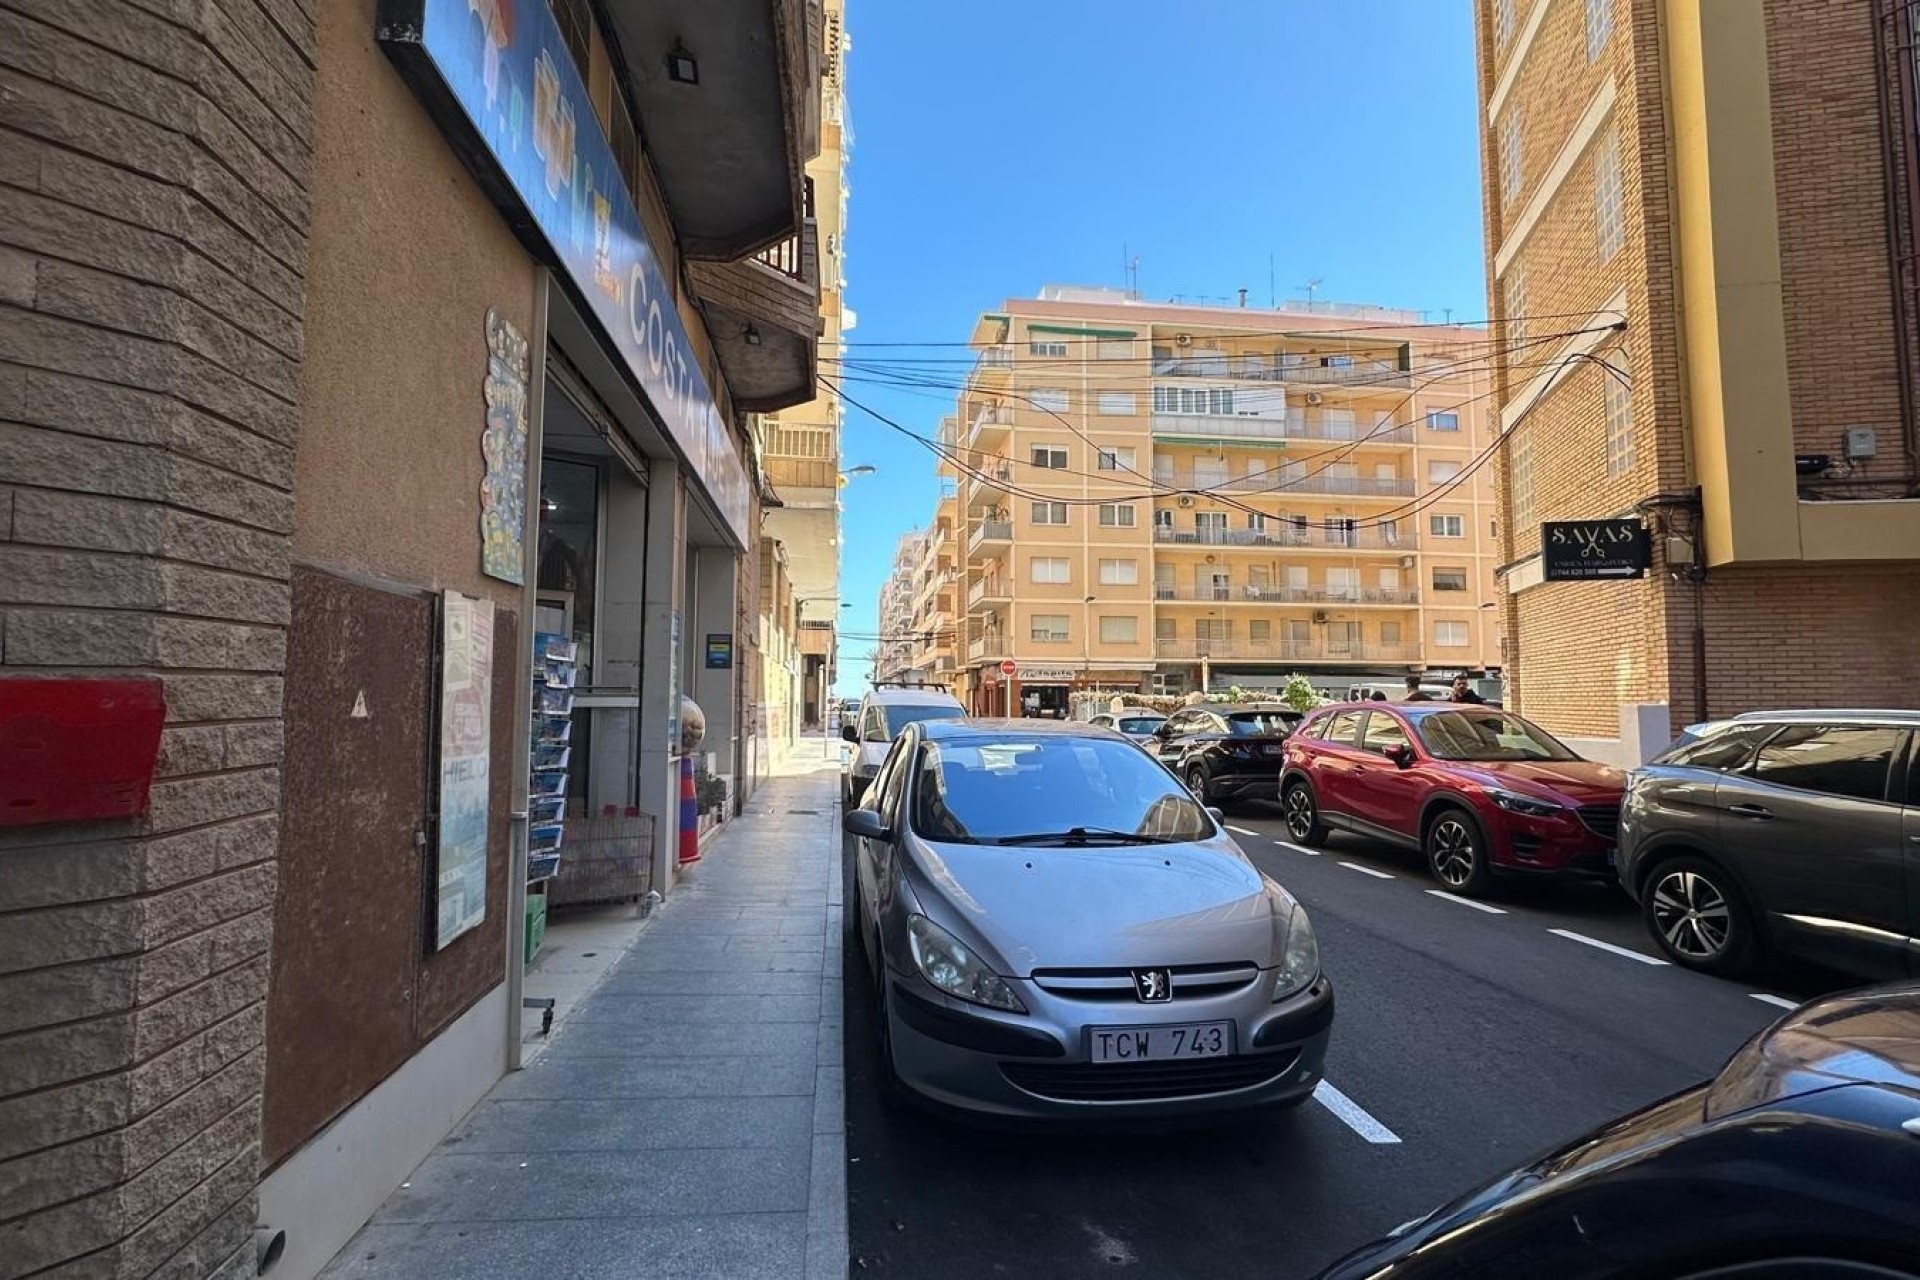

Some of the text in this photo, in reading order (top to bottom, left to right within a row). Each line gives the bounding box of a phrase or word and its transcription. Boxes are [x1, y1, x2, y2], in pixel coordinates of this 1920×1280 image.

[630, 262, 695, 438] COSTA
[1552, 524, 1634, 545] SAVAS
[442, 756, 487, 785] HIELO
[1097, 1028, 1223, 1059] TCW 743
